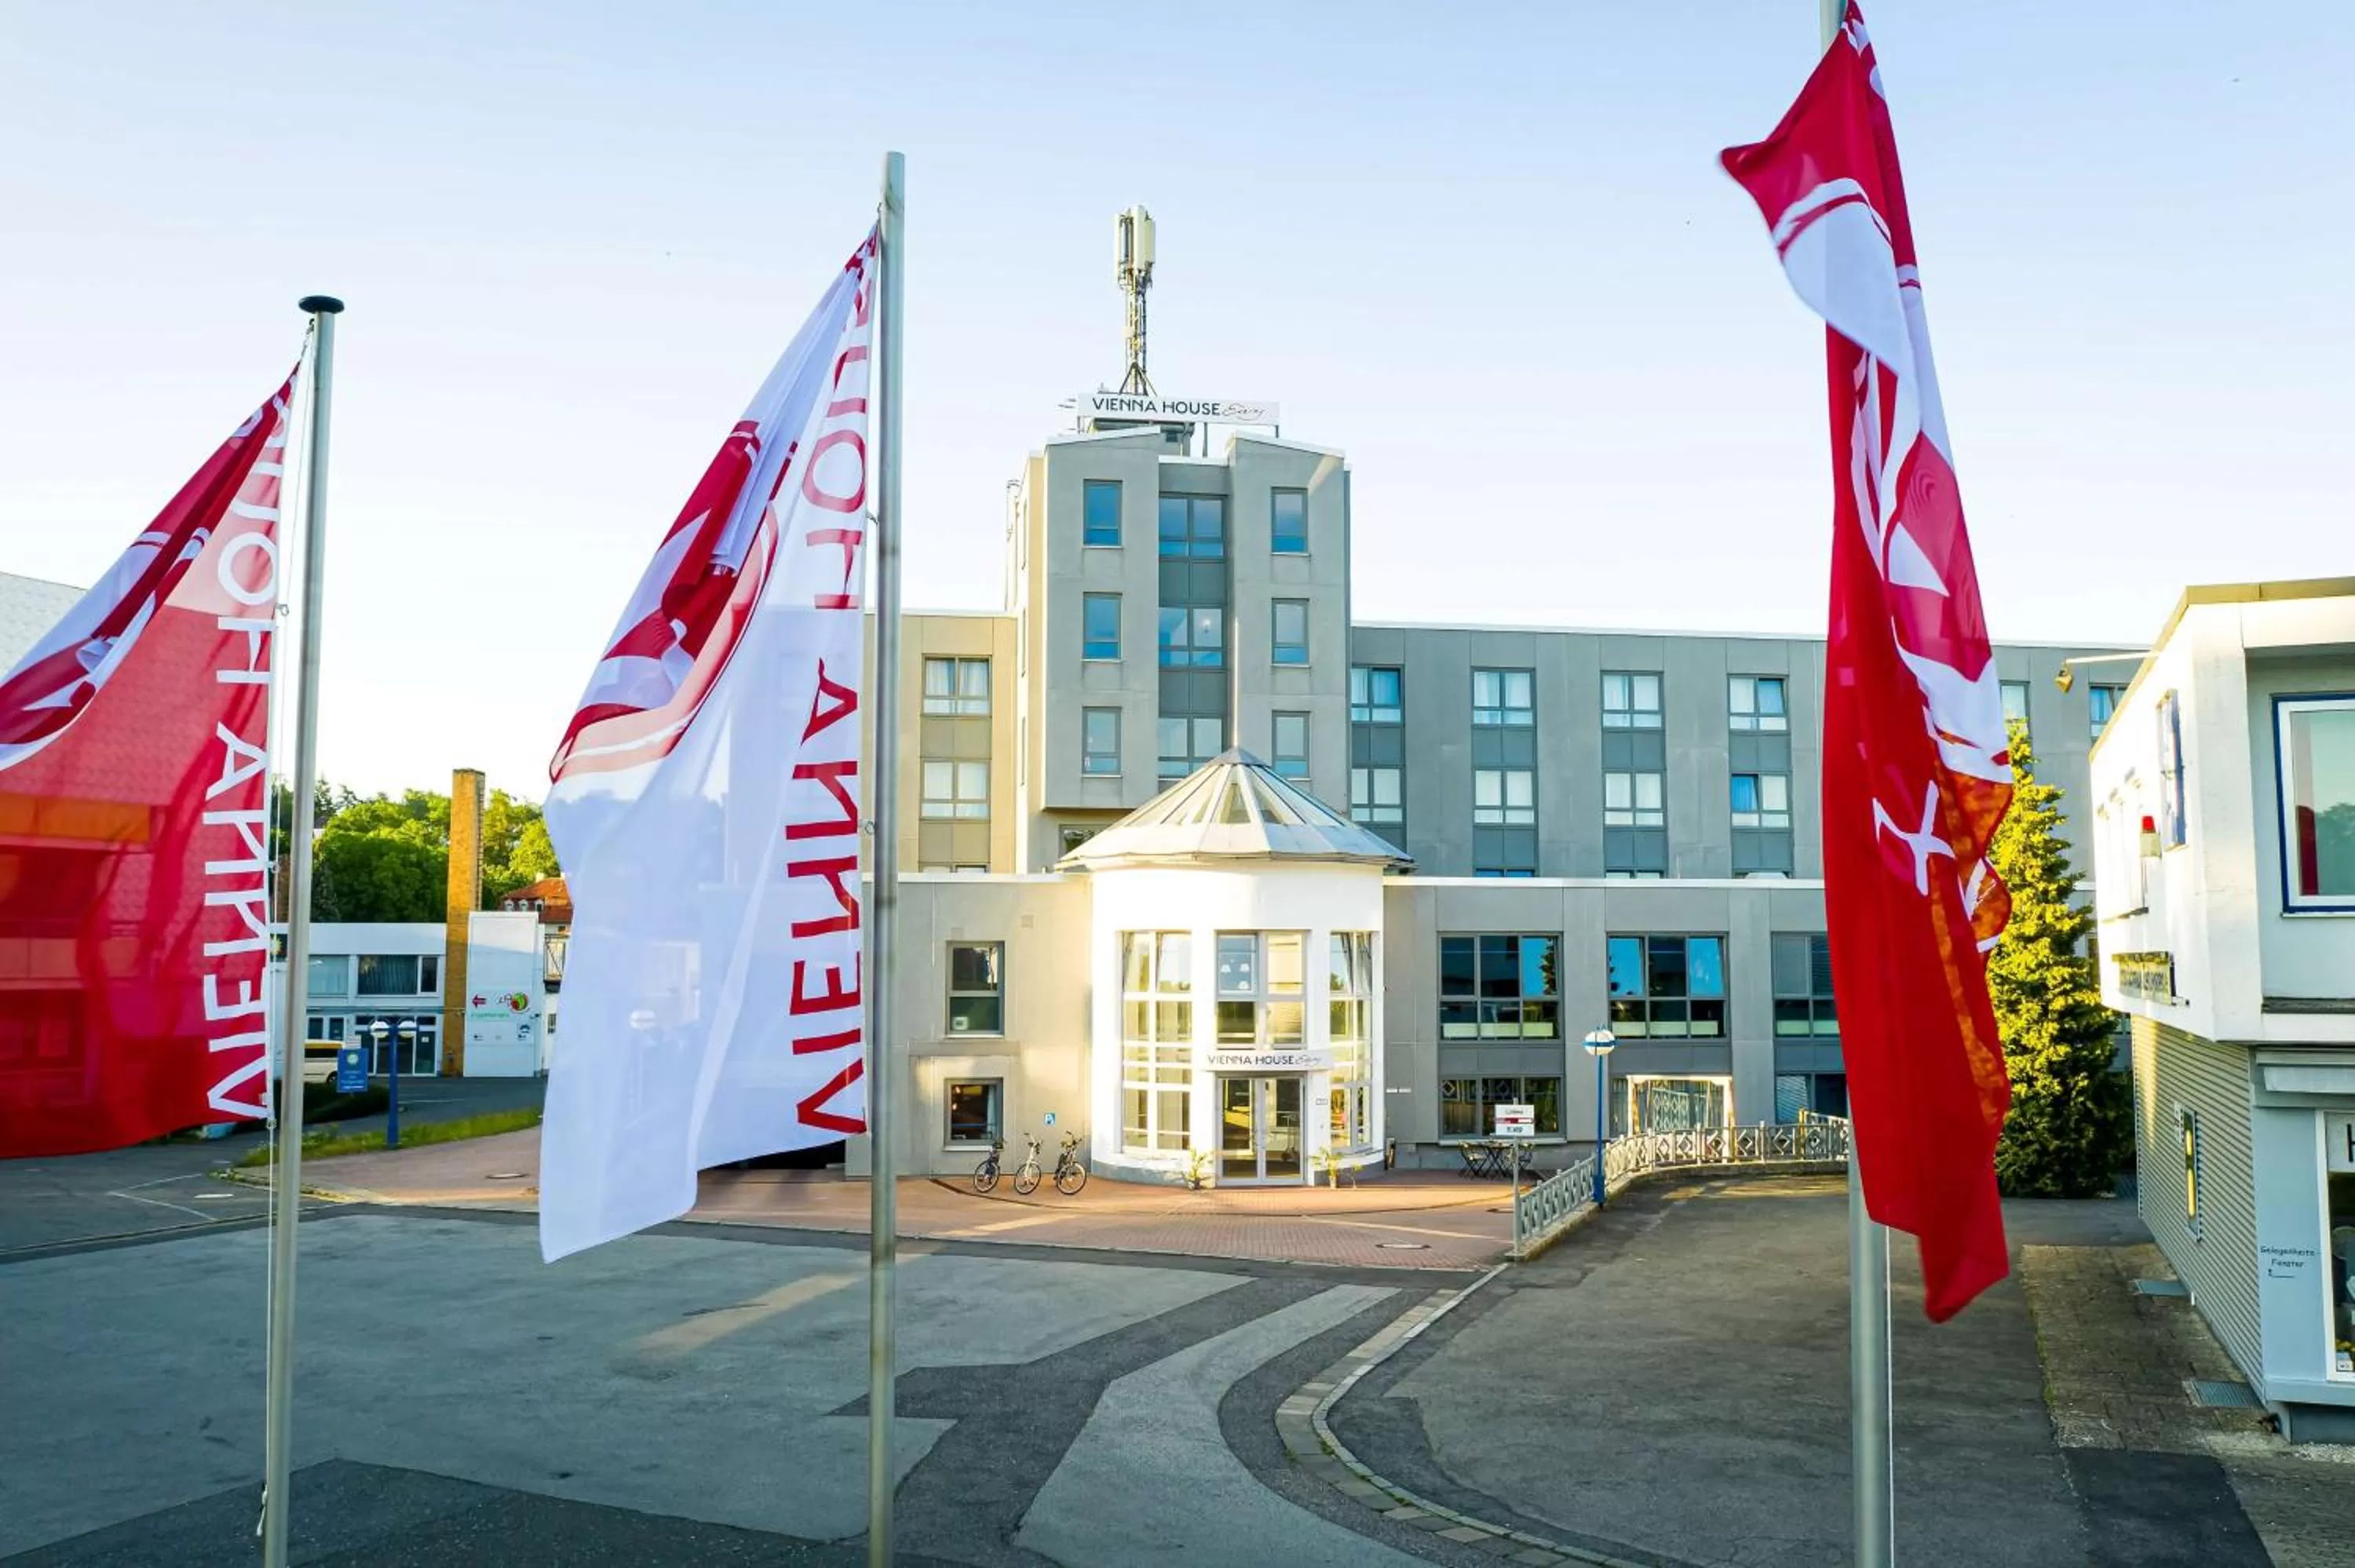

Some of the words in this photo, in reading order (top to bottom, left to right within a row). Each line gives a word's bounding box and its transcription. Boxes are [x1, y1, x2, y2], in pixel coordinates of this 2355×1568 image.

[1092, 398, 1158, 414] VIENNA
[1163, 402, 1221, 416] HOUSE
[1207, 1055, 1252, 1065] VIENNA
[1256, 1056, 1294, 1065] HOUSE
